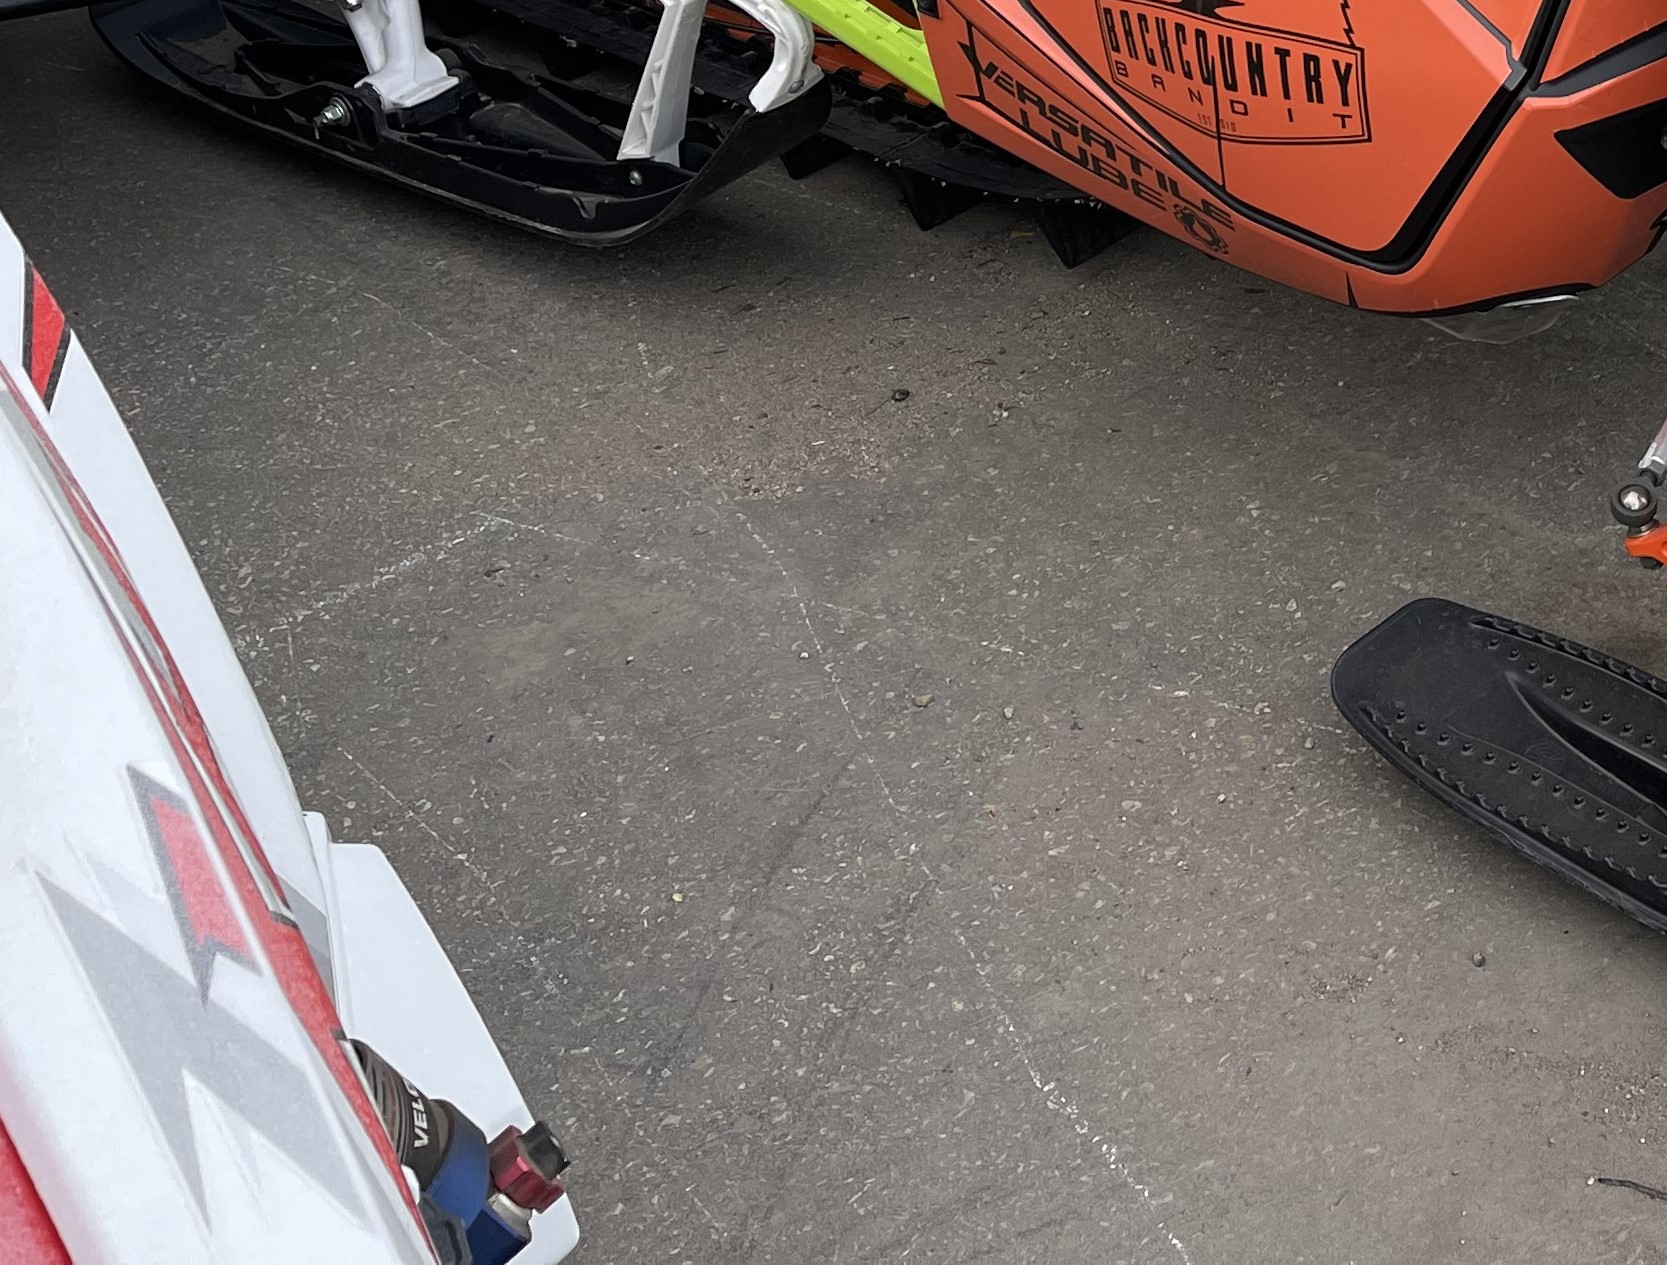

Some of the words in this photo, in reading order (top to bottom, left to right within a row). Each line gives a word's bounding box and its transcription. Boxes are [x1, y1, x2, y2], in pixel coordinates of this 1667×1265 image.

[1103, 7, 1353, 107] BACKCOUNTRY
[957, 40, 1236, 232] VERSATILE
[1019, 107, 1168, 212] LUBE
